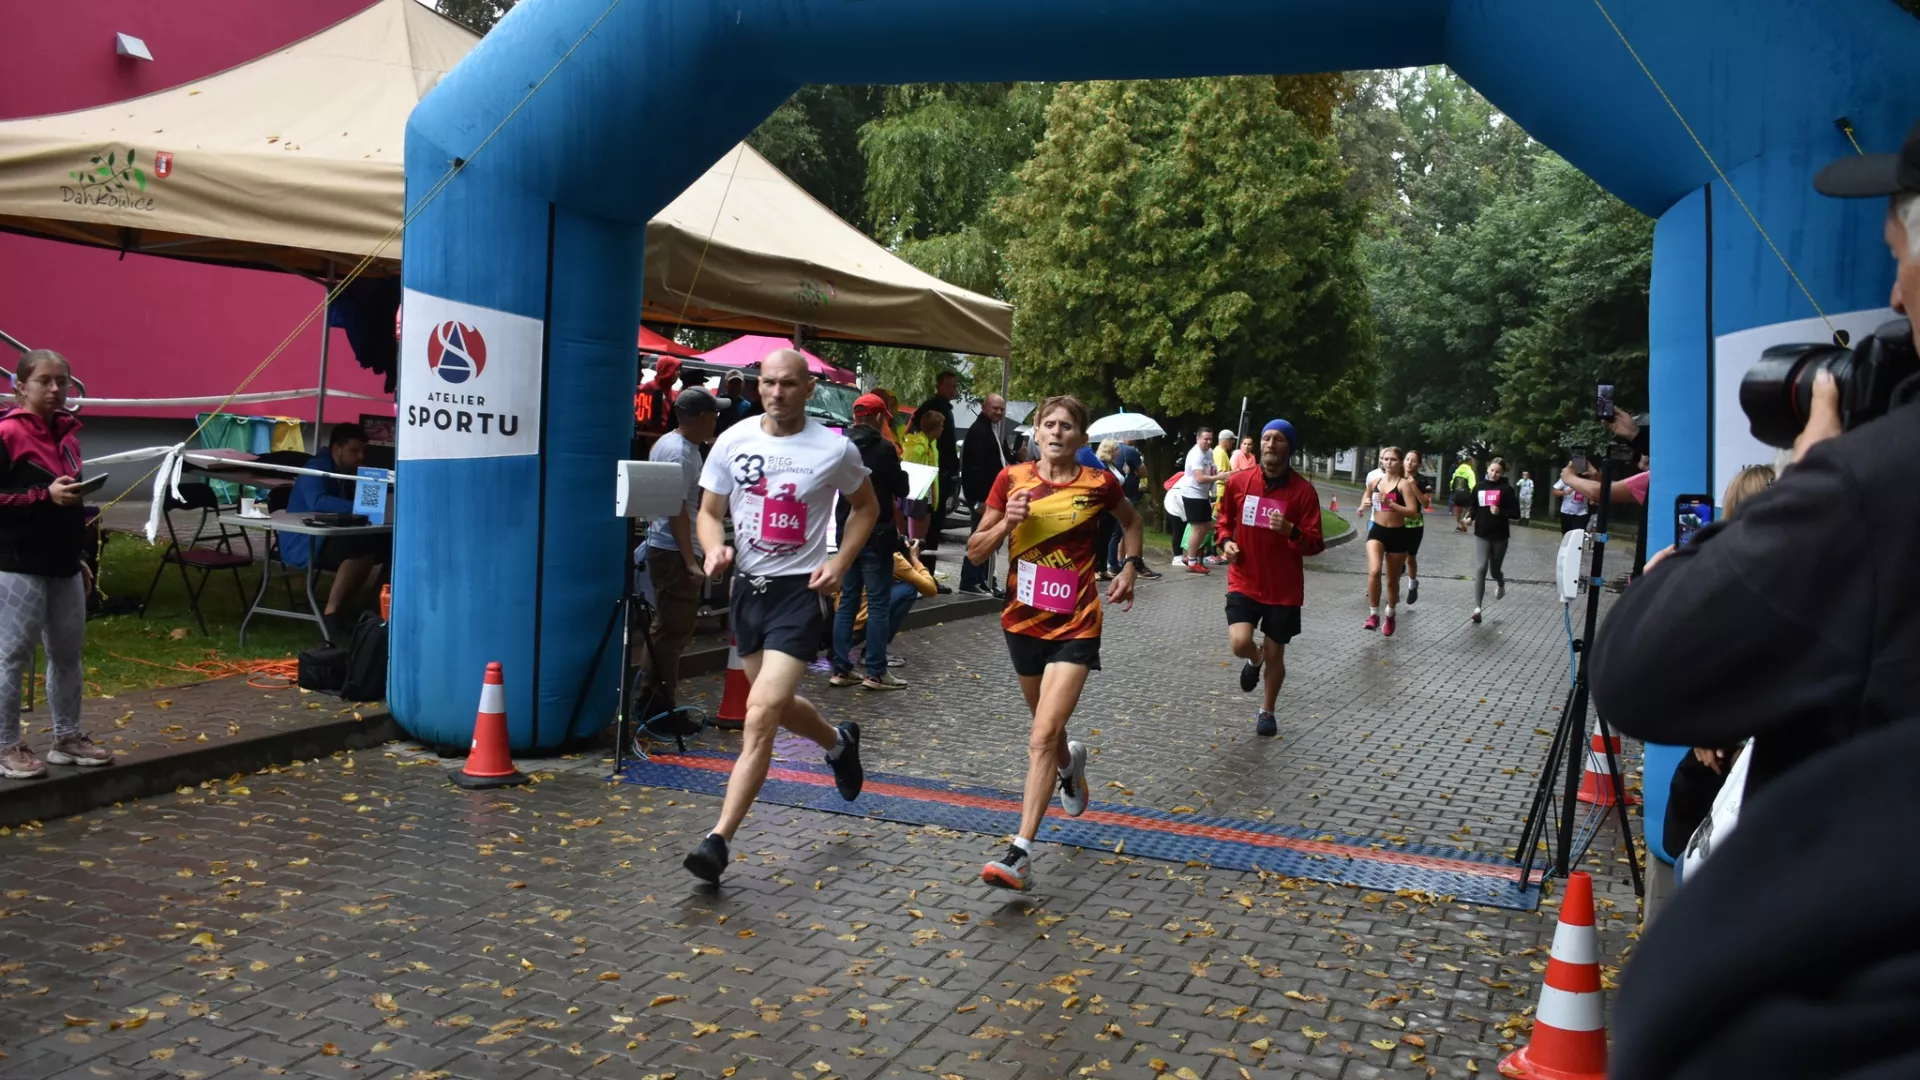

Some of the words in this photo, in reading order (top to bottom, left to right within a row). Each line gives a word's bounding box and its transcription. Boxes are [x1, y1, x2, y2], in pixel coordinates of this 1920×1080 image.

[428, 392, 485, 406] ATELIER
[407, 405, 519, 436] SPORTU
[734, 453, 765, 485] 33
[768, 456, 793, 466] BIEG
[769, 512, 800, 529] 184
[1040, 581, 1071, 599] 100
